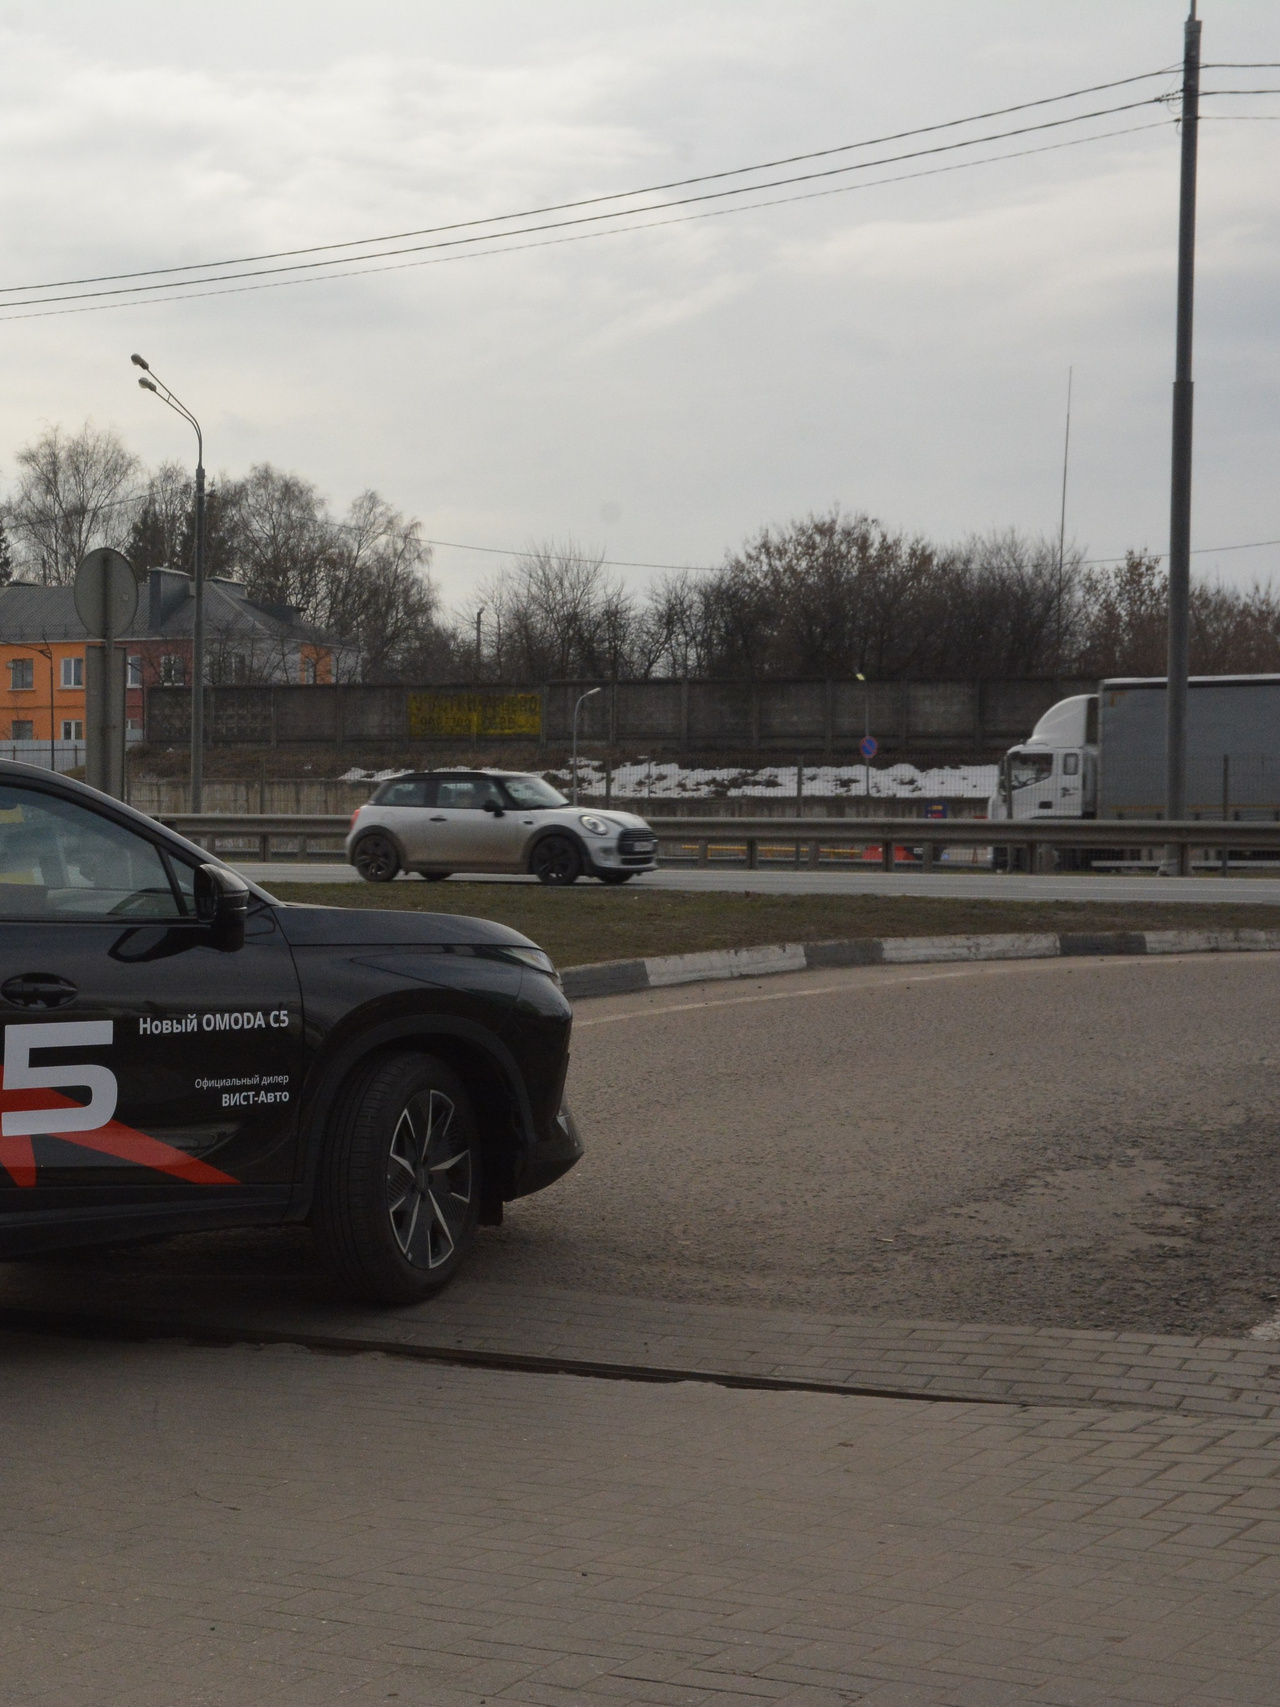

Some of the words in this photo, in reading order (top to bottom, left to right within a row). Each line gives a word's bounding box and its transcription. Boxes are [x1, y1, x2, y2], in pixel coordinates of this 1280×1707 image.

[139, 1014, 198, 1035] Новый
[202, 1011, 266, 1032] OMODA
[269, 1010, 289, 1028] C5
[194, 1074, 260, 1090] Официальный
[261, 1075, 289, 1086] дилер
[222, 1090, 290, 1107] ВИСТ-Авто
